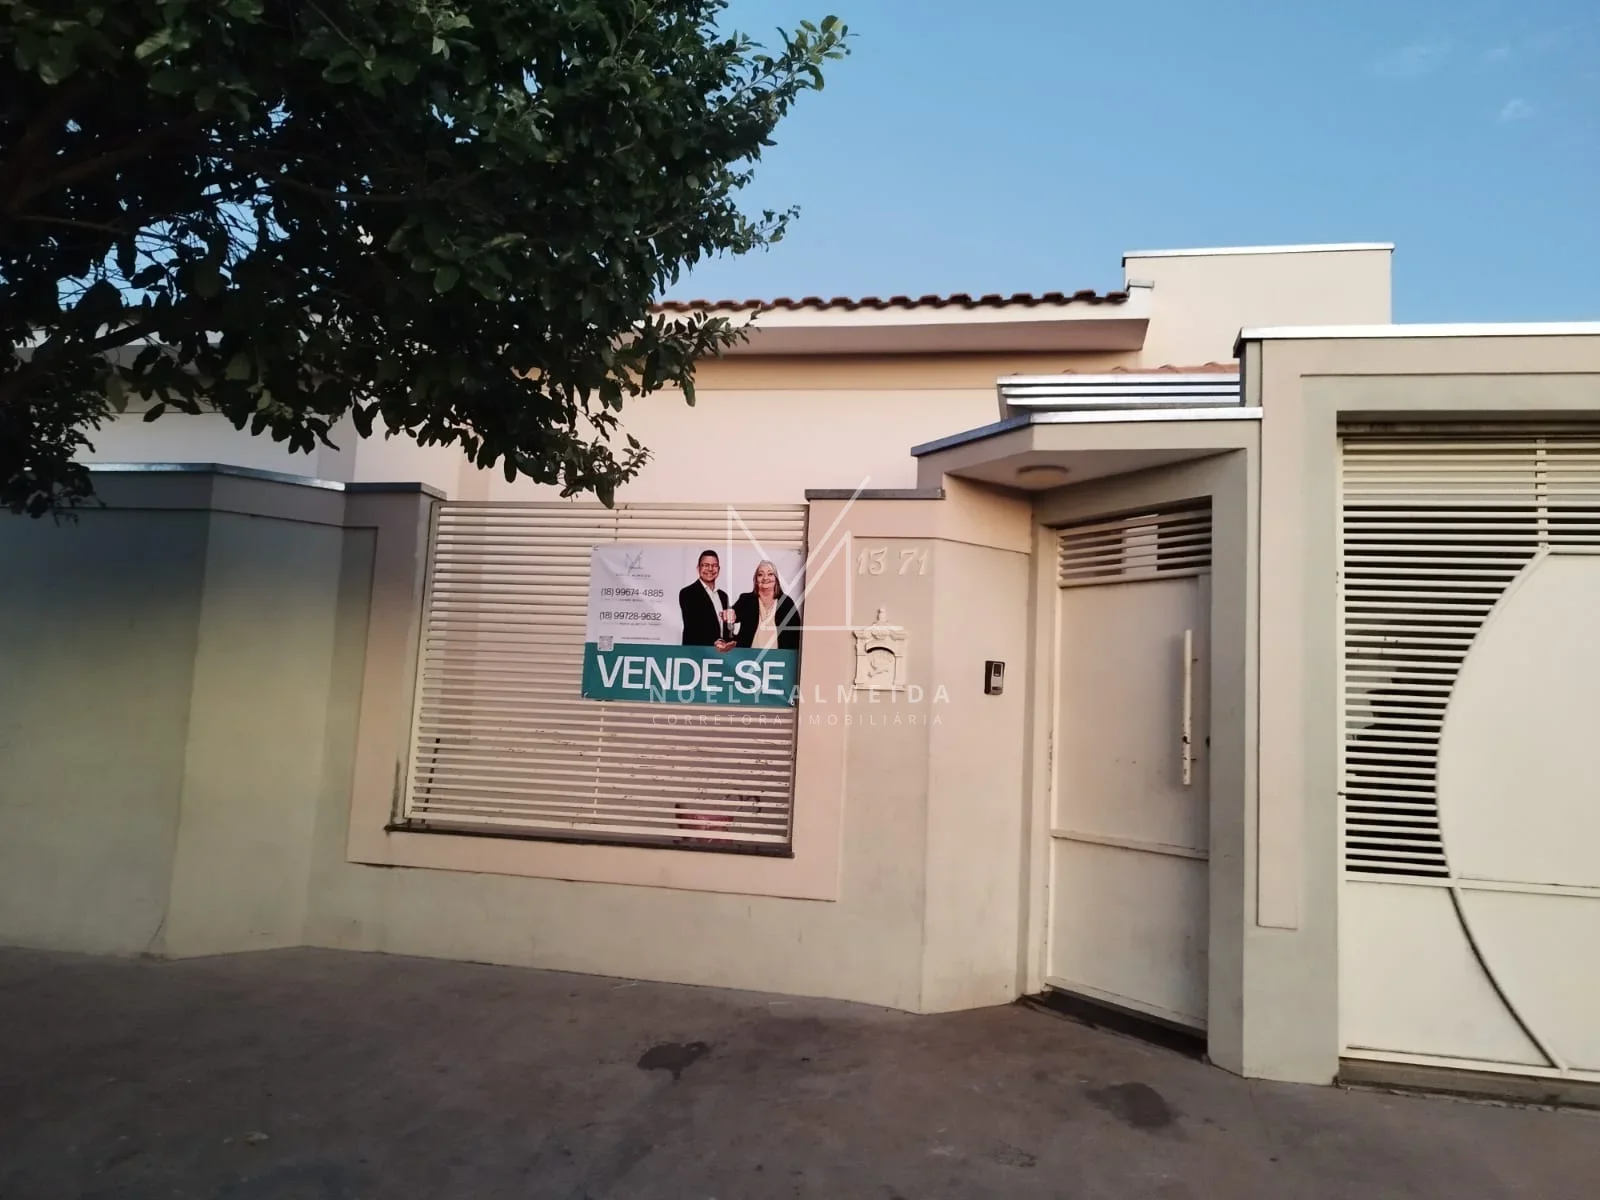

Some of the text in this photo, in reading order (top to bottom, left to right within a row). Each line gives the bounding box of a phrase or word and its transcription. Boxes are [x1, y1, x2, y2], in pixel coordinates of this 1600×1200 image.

[600, 587, 614, 597] (18)
[599, 611, 662, 621] (18) 99728-9632
[597, 655, 786, 697] VENDE-SE
